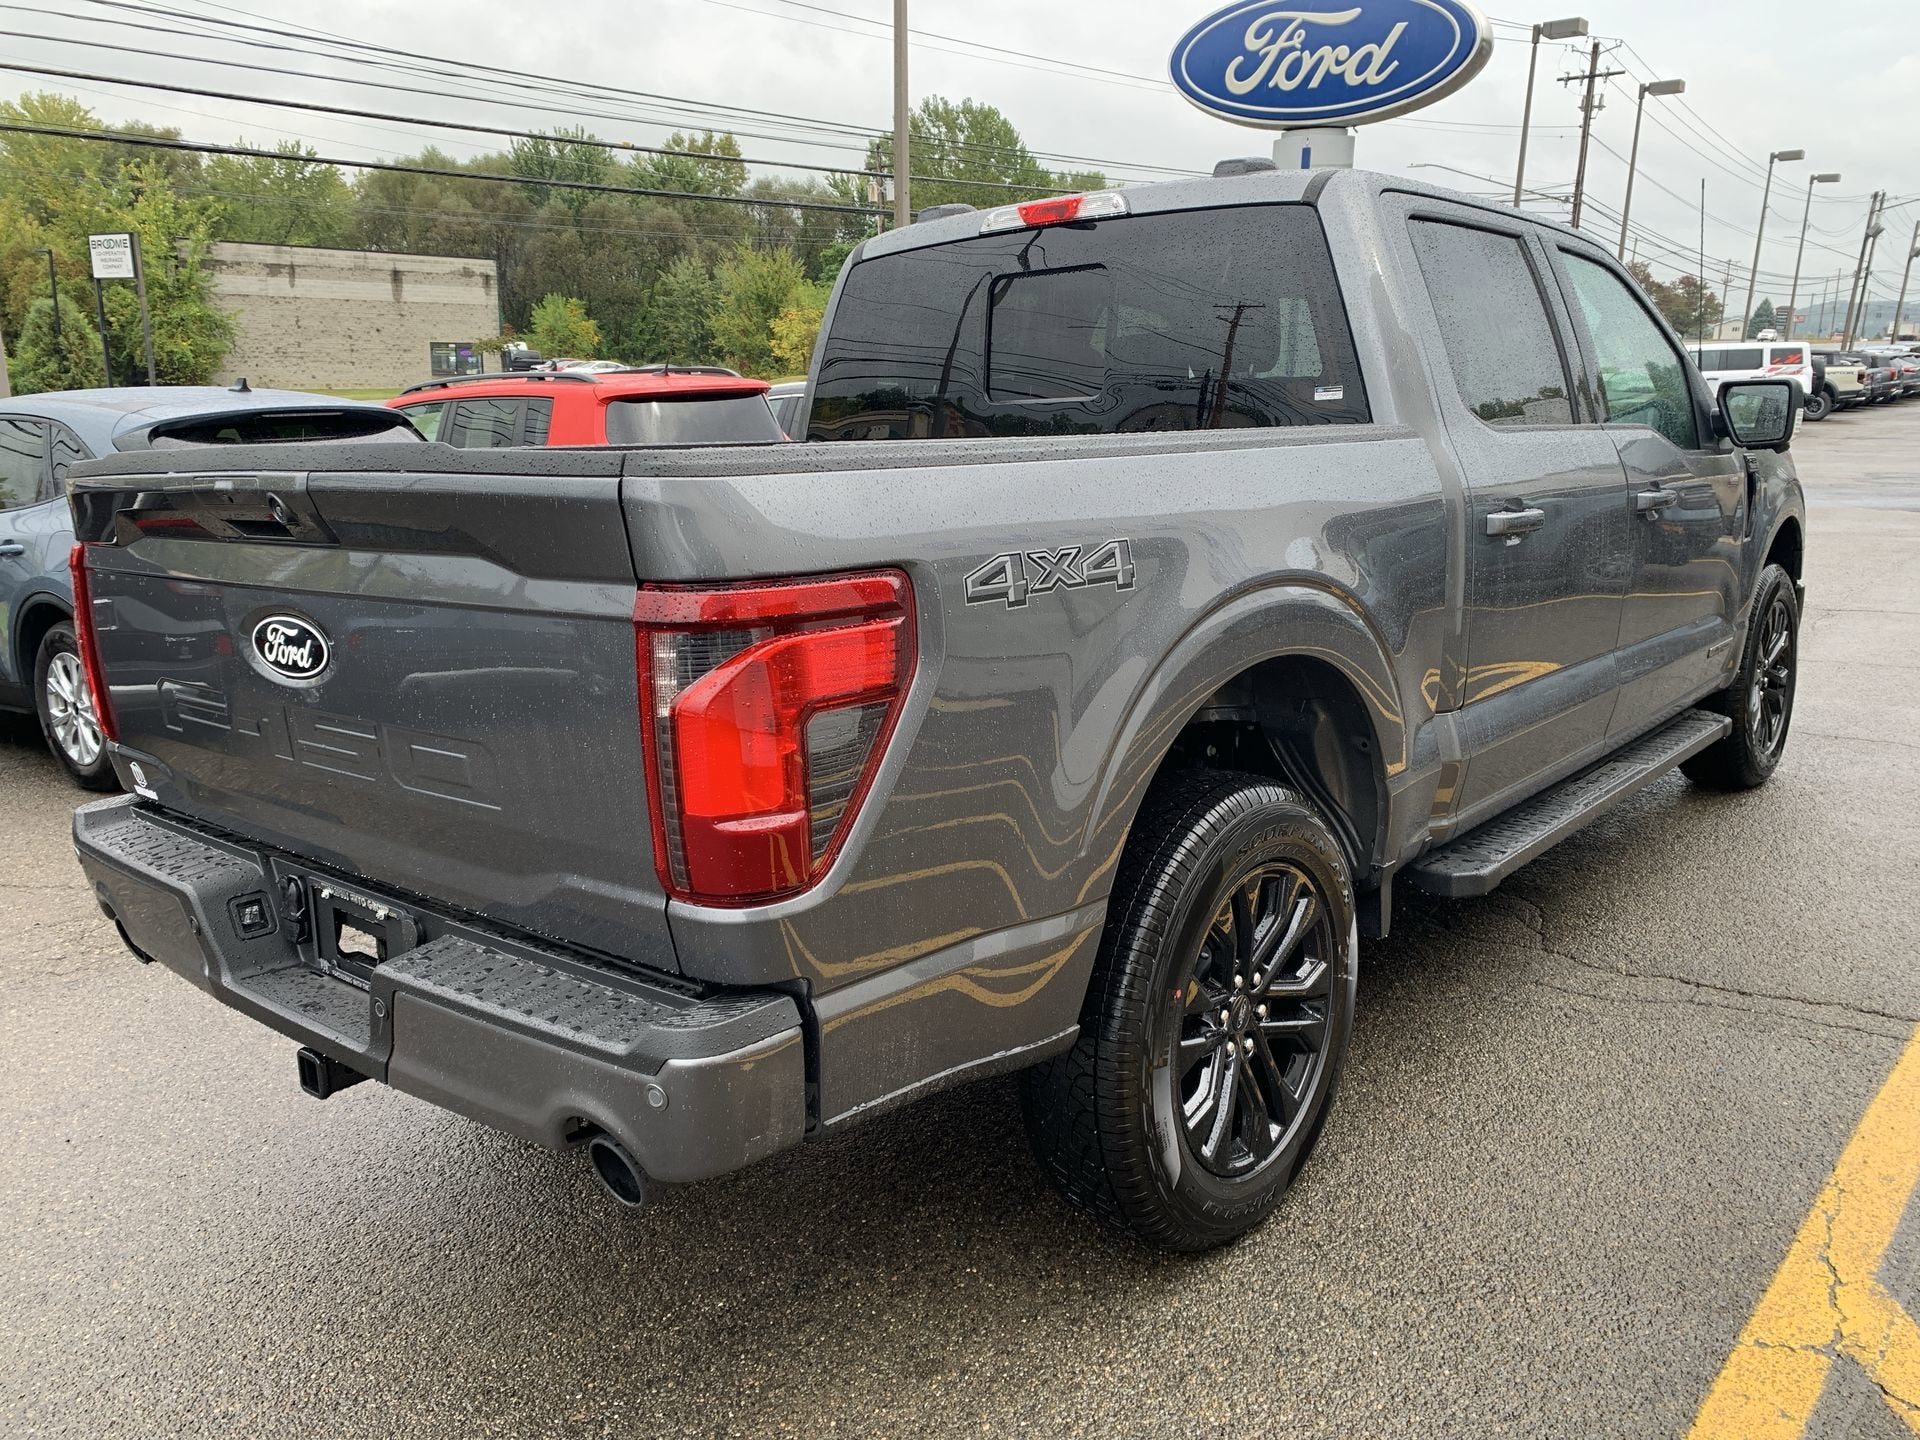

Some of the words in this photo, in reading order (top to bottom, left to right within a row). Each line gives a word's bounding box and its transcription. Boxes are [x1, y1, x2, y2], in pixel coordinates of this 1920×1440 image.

[1225, 8, 1408, 95] Ford
[91, 239, 128, 249] BROOME
[963, 538, 1136, 610] 4X4
[264, 623, 312, 669] Ford
